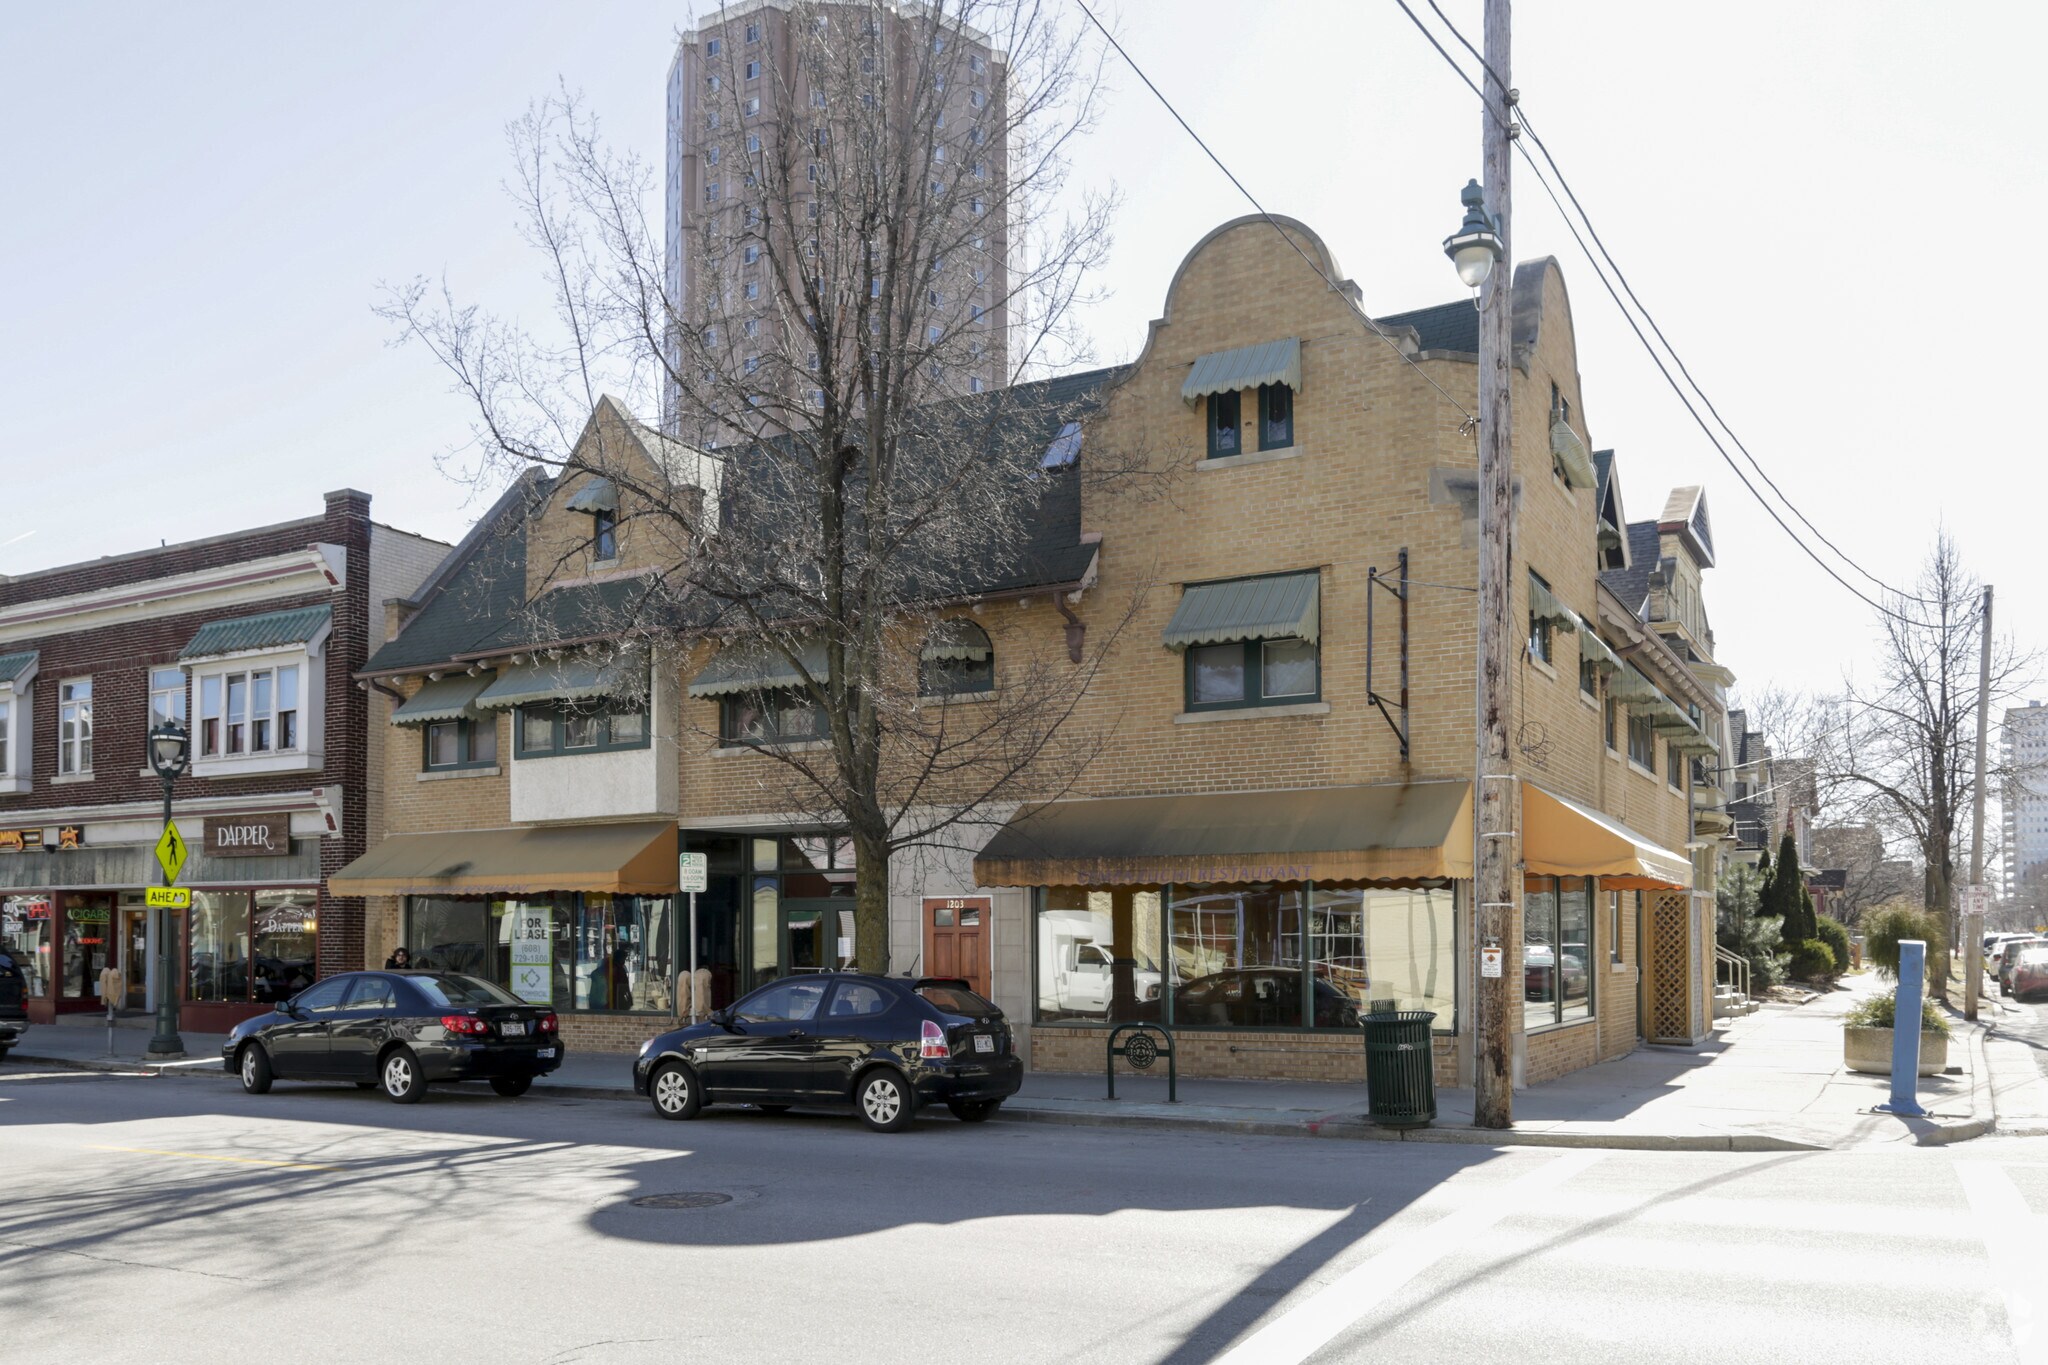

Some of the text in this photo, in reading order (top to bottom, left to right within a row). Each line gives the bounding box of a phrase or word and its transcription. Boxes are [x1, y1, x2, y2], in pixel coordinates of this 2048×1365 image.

[218, 825, 275, 850] DAPPER
[1198, 865, 1313, 881] RESTAURANT
[946, 899, 964, 909] 1203
[514, 929, 548, 940] LEASE
